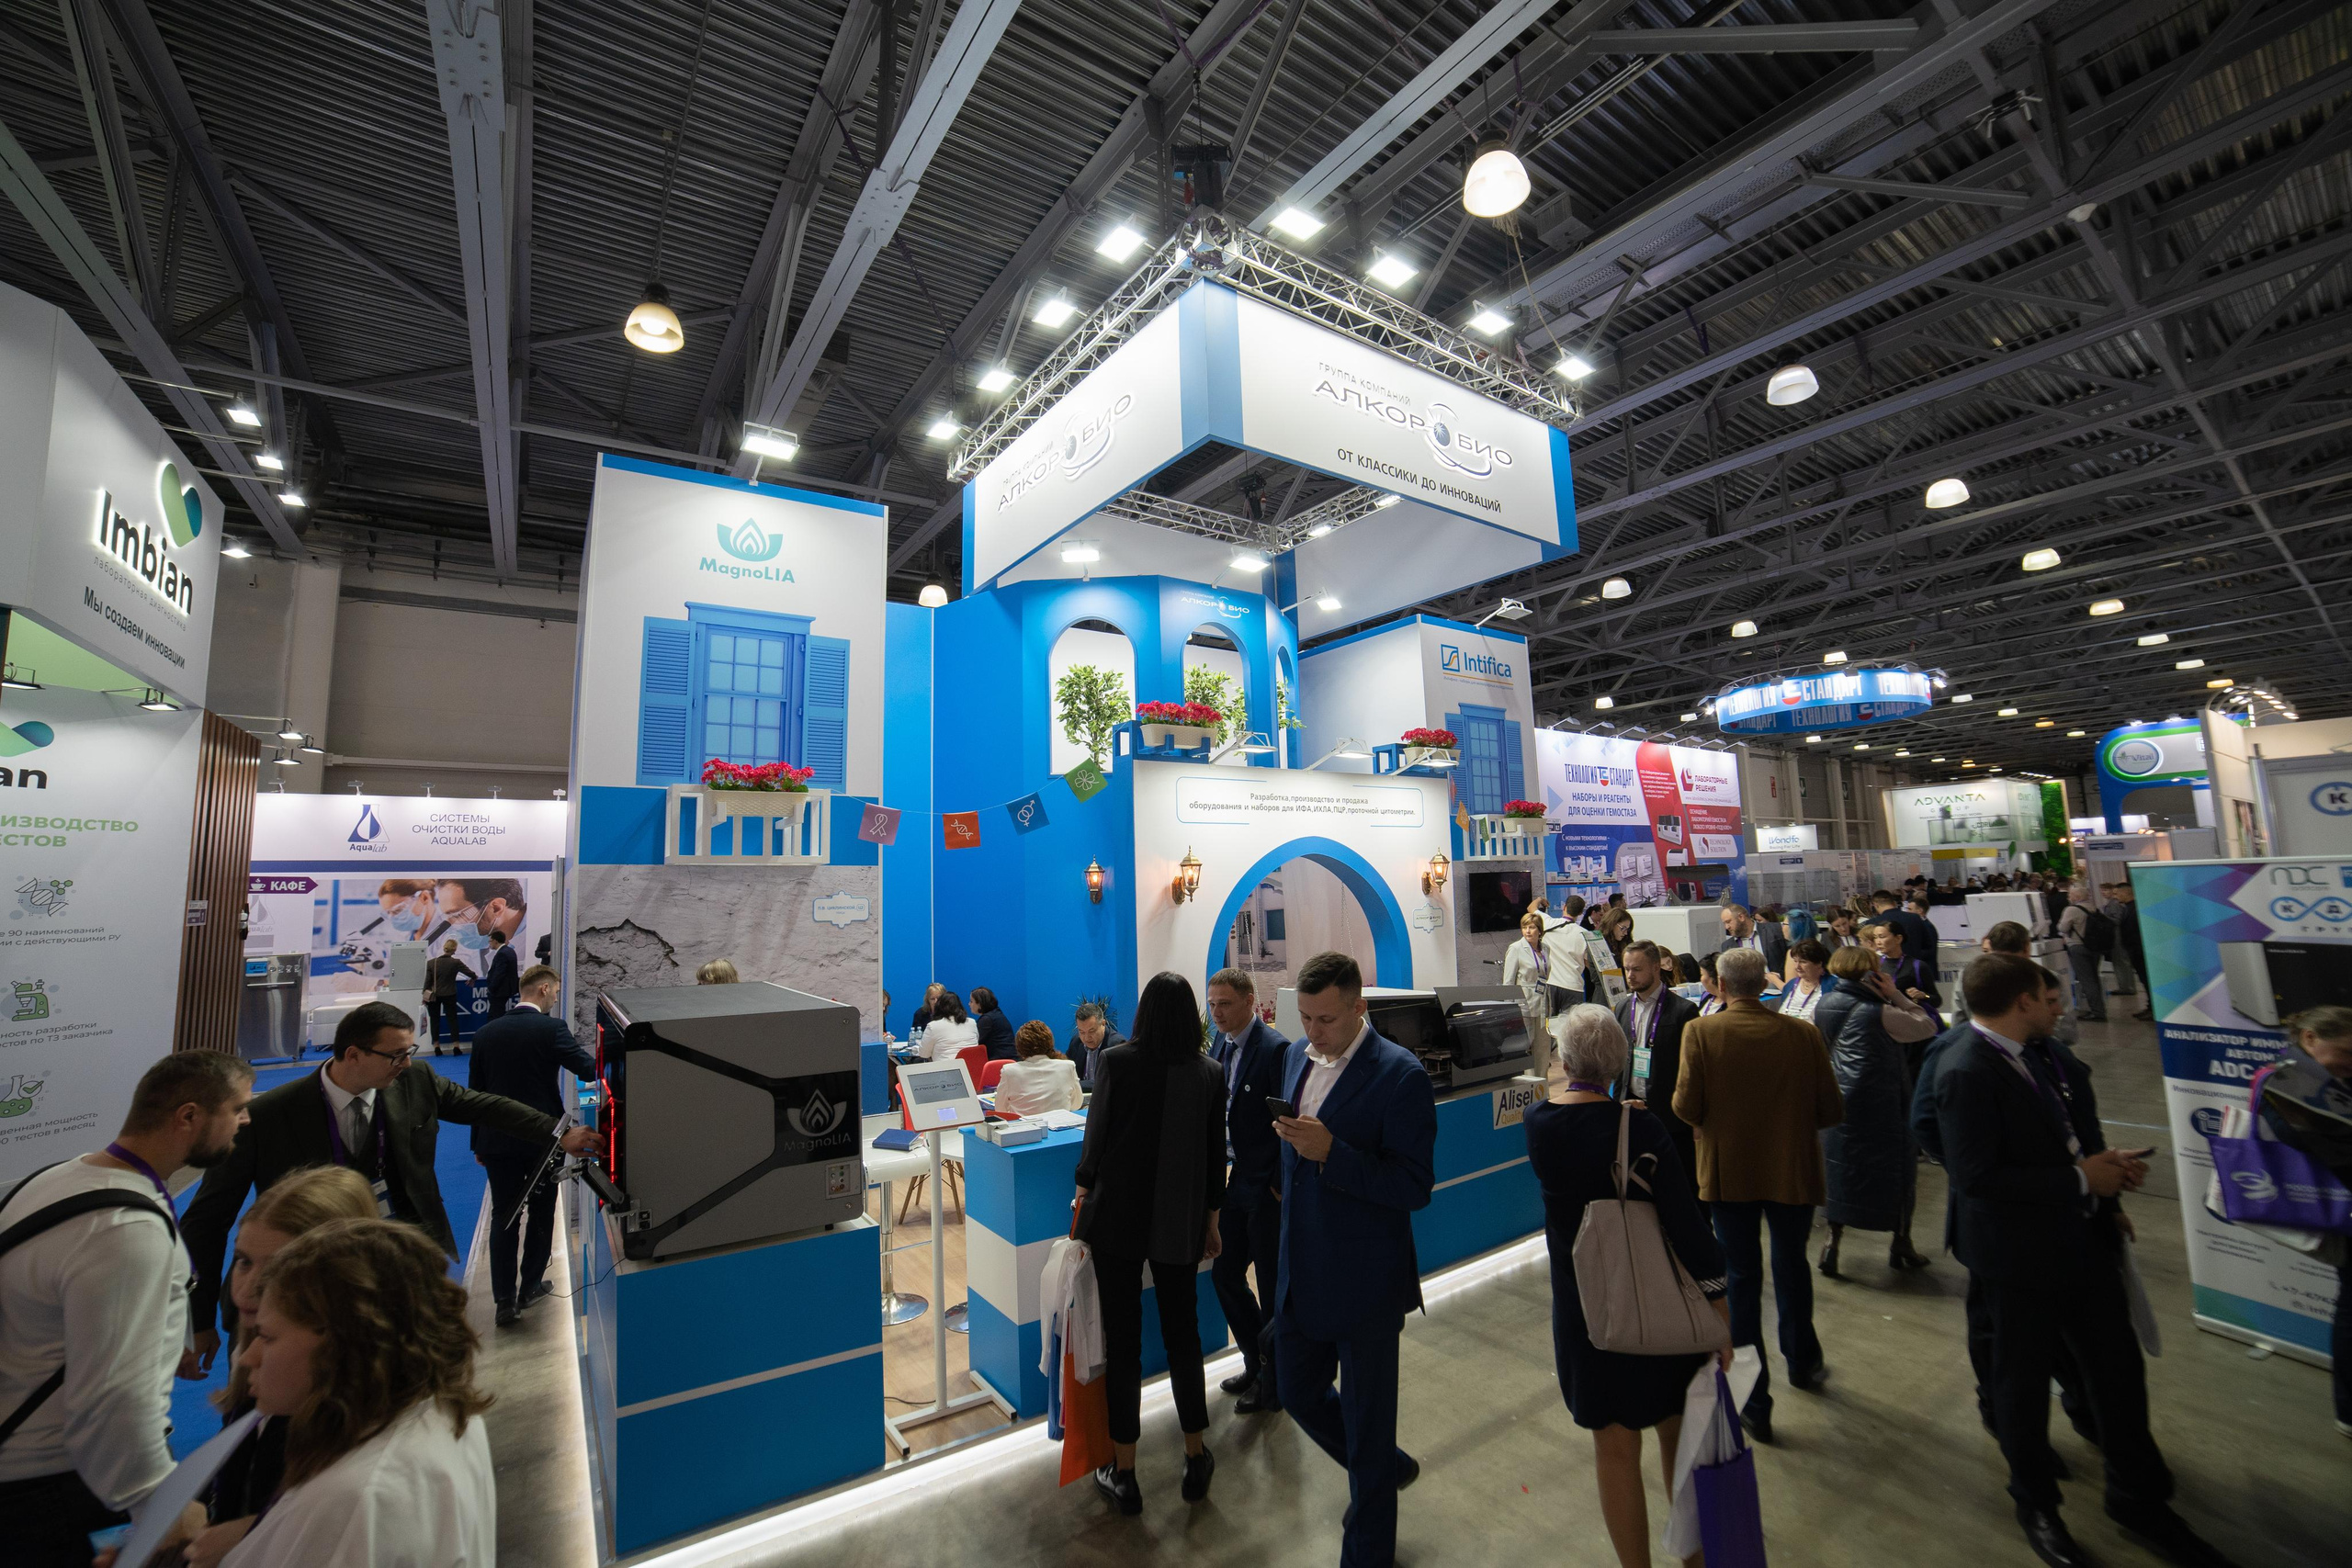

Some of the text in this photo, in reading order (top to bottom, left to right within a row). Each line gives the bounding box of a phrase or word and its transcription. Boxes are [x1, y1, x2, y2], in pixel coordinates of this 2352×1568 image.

[1318, 362, 1411, 406] ГРУППА КОМПАНИЙ
[1315, 379, 1513, 466] АЛКОР БИО
[998, 451, 1060, 512] АЛКОР
[1082, 394, 1132, 444] БИО
[1337, 447, 1501, 513] ОТ КЛАССИКИ ДО ИННОВАЦИЙ
[98, 490, 194, 615] Imbian
[698, 557, 796, 583] MagnoLIA
[93, 555, 187, 632] лабораторная диагностика
[1181, 596, 1250, 614] АЛКОР БИО
[84, 585, 186, 670] Мы создаем инновации
[1464, 652, 1512, 678] Intifica
[1803, 675, 1862, 701] СТАНДАРТ
[1792, 704, 1852, 727] ТЕХНОЛОГИЯ
[1565, 763, 1598, 784] ТЕХНОЛОГИЯ
[1610, 767, 1634, 789] СТАНДАРТ
[1695, 775, 1728, 784] ЛАБОРАТОРНЫЕ
[1696, 784, 1716, 793] РЕШЕНИЯ
[1189, 801, 1242, 811] оборудования
[1251, 804, 1280, 812] наборов
[1572, 792, 1597, 802] НАБОРЫ
[1603, 795, 1632, 804] РЕАГЕНТЫ
[1914, 793, 1985, 807] ADVANTA
[430, 813, 490, 823] СИСТЕМЫ
[1568, 807, 1637, 817] ДЛЯ ОЦЕНКИ ГЕМОСТАЗА
[1, 815, 139, 832] ИЗВОДСТВО
[412, 824, 505, 835] ОЧИСТКИ ВОДЫ
[349, 843, 388, 853] Aqualab
[431, 836, 487, 846] AQUALAB
[270, 881, 307, 891] КАФЕ
[25, 926, 105, 937] наименований
[24, 935, 107, 946] действующими
[35, 1021, 97, 1036] разработки
[62, 1029, 114, 1041] заказчика
[2164, 1028, 2291, 1050] АНАЛИЗАТОР ИММ
[1495, 1084, 1534, 1126] Alisei
[44, 1112, 99, 1126] мощность
[15, 1130, 51, 1143] тестов
[62, 1121, 96, 1133] месяц
[784, 1132, 853, 1152] MagnoLIA
